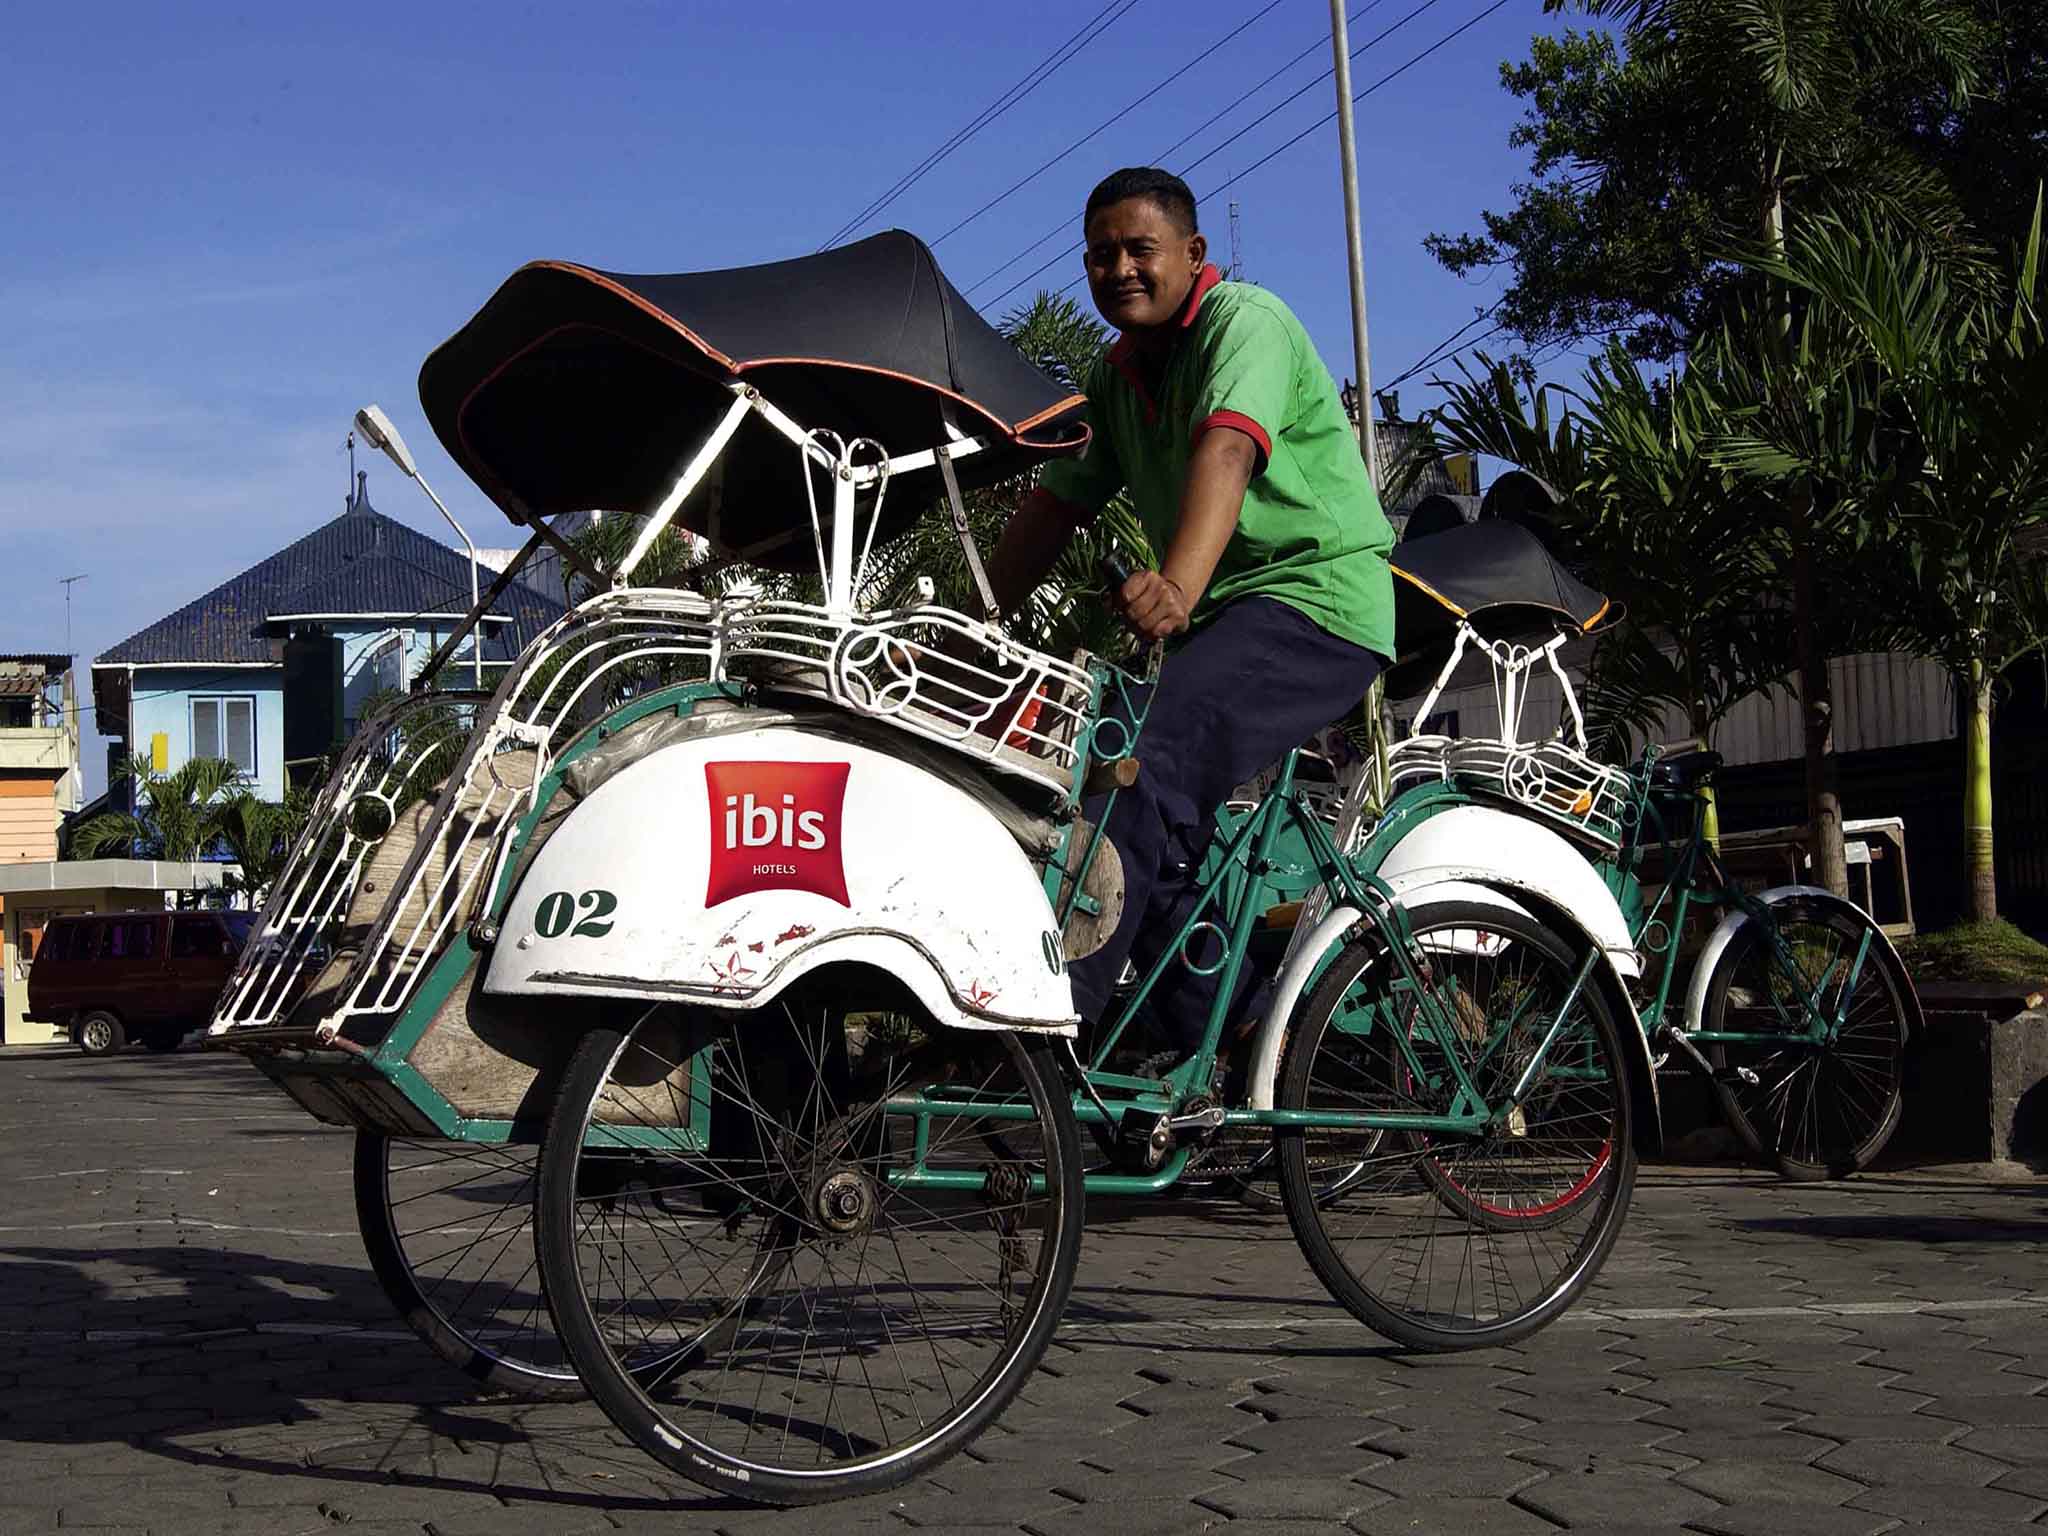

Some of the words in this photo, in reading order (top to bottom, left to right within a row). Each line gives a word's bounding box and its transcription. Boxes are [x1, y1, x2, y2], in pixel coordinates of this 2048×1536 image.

[726, 793, 826, 850] ibis
[753, 864, 796, 875] HOTELS
[534, 889, 618, 938] 02
